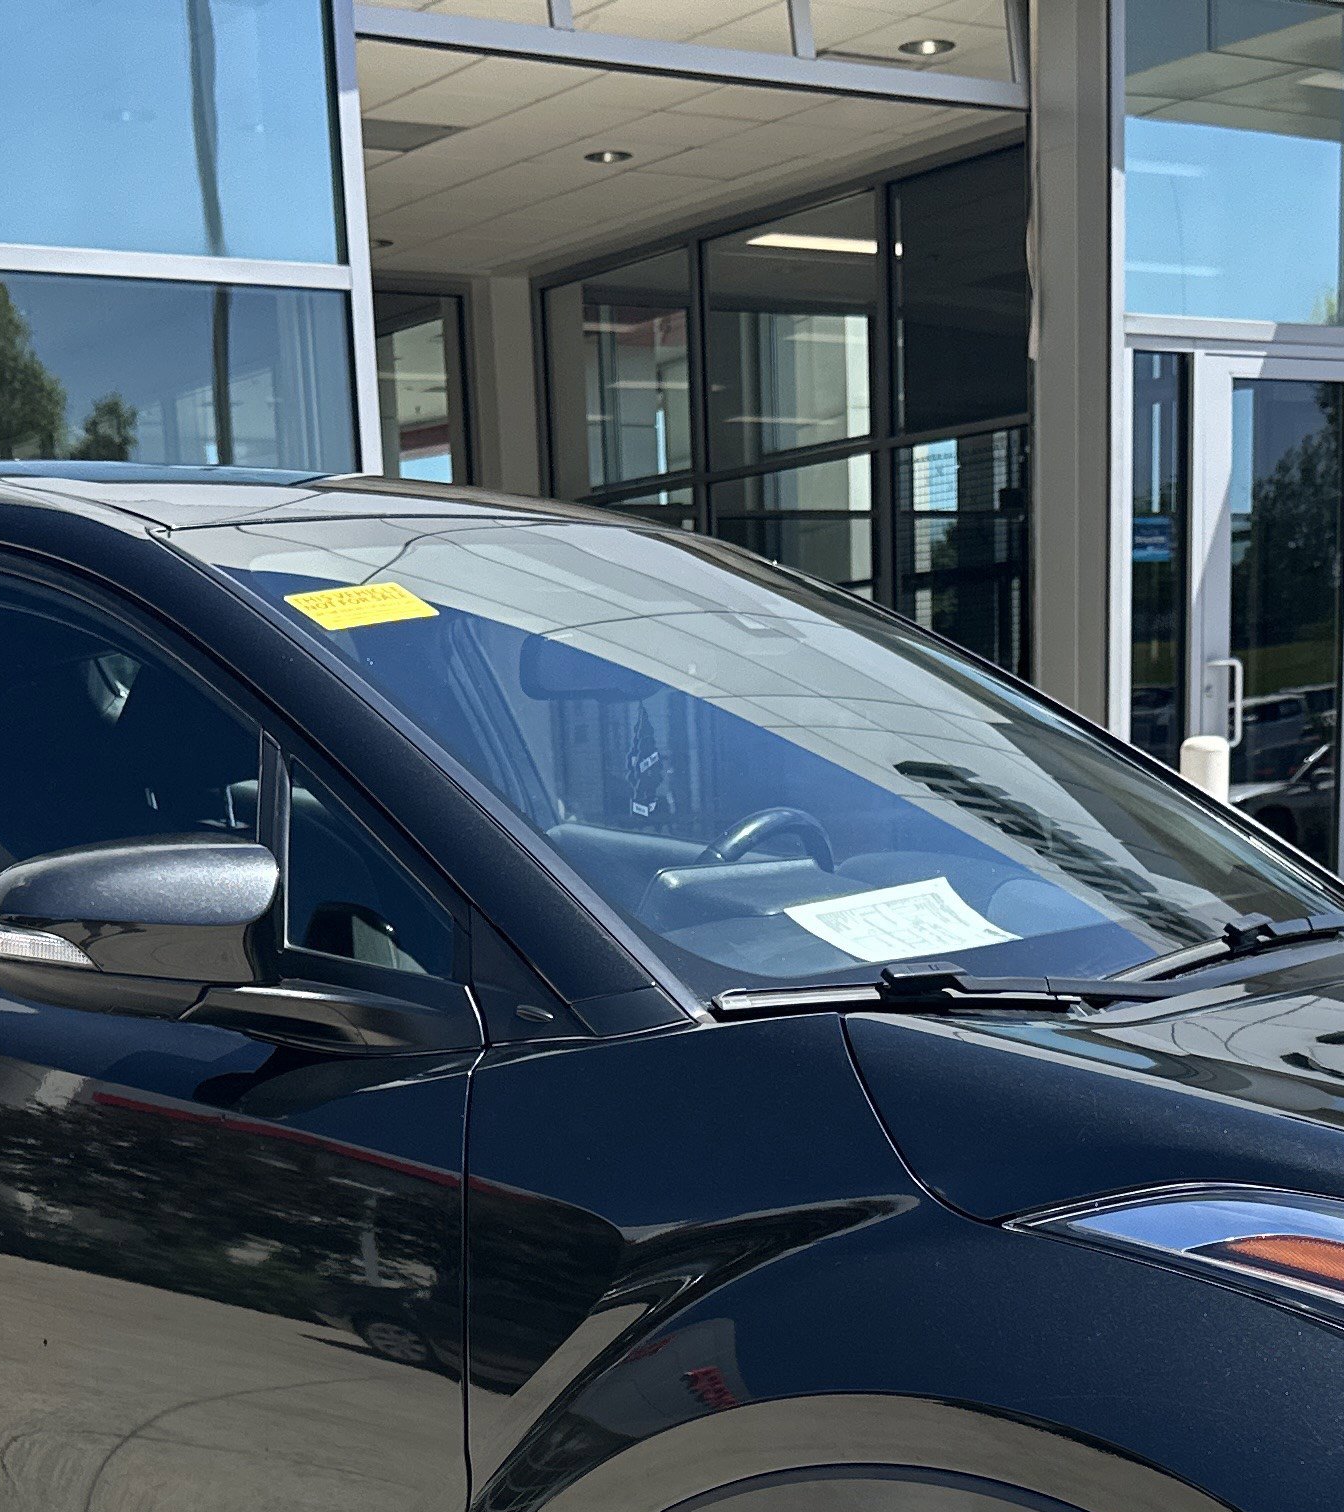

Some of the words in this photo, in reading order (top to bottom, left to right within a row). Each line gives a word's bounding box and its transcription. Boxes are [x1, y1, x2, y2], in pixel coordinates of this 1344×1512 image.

[293, 593, 332, 604] THIS
[303, 601, 338, 611] NOT
[339, 597, 366, 606] FOR
